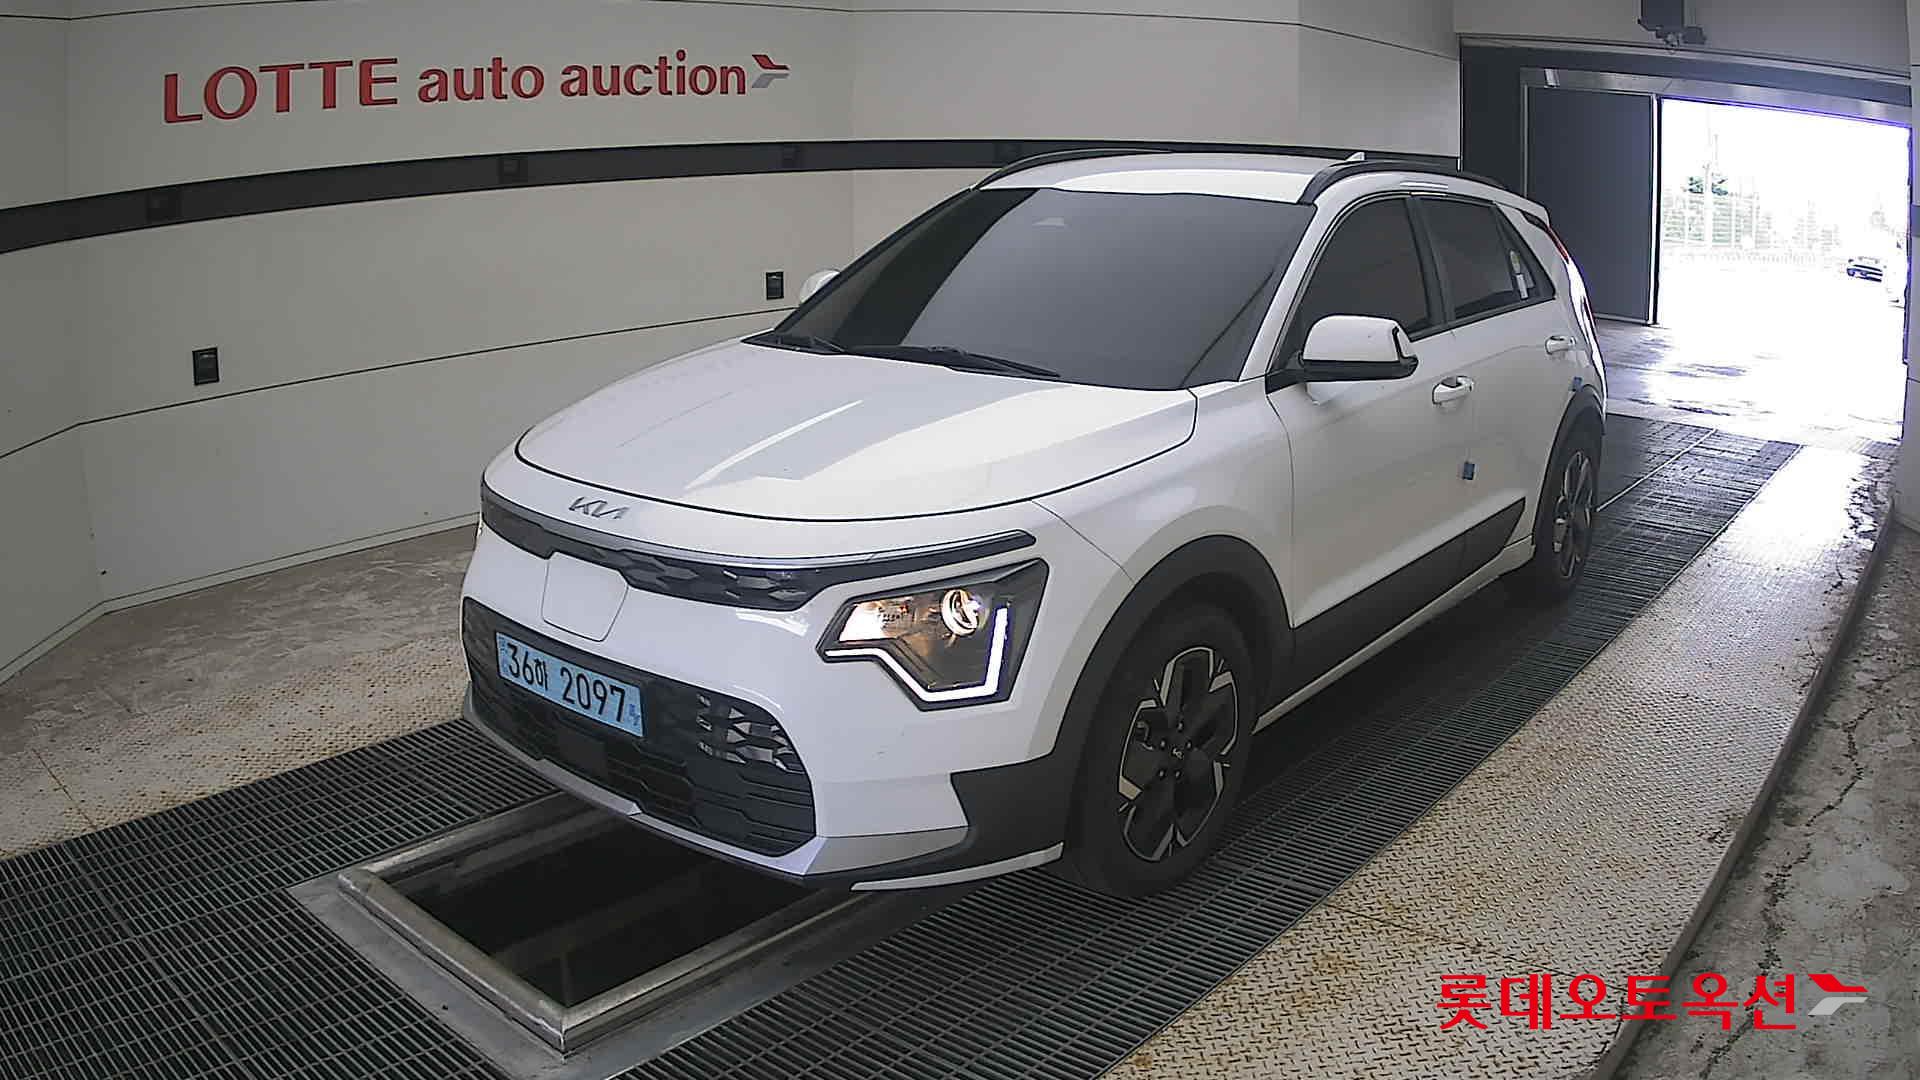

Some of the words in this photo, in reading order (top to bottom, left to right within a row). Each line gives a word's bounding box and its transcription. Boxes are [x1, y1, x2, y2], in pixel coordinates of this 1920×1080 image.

[164, 57, 398, 124] LOTTE
[418, 56, 545, 104] auto
[559, 49, 748, 98] auction
[568, 496, 631, 520] KIA
[507, 642, 549, 692] 36하
[559, 666, 626, 723] 2097
